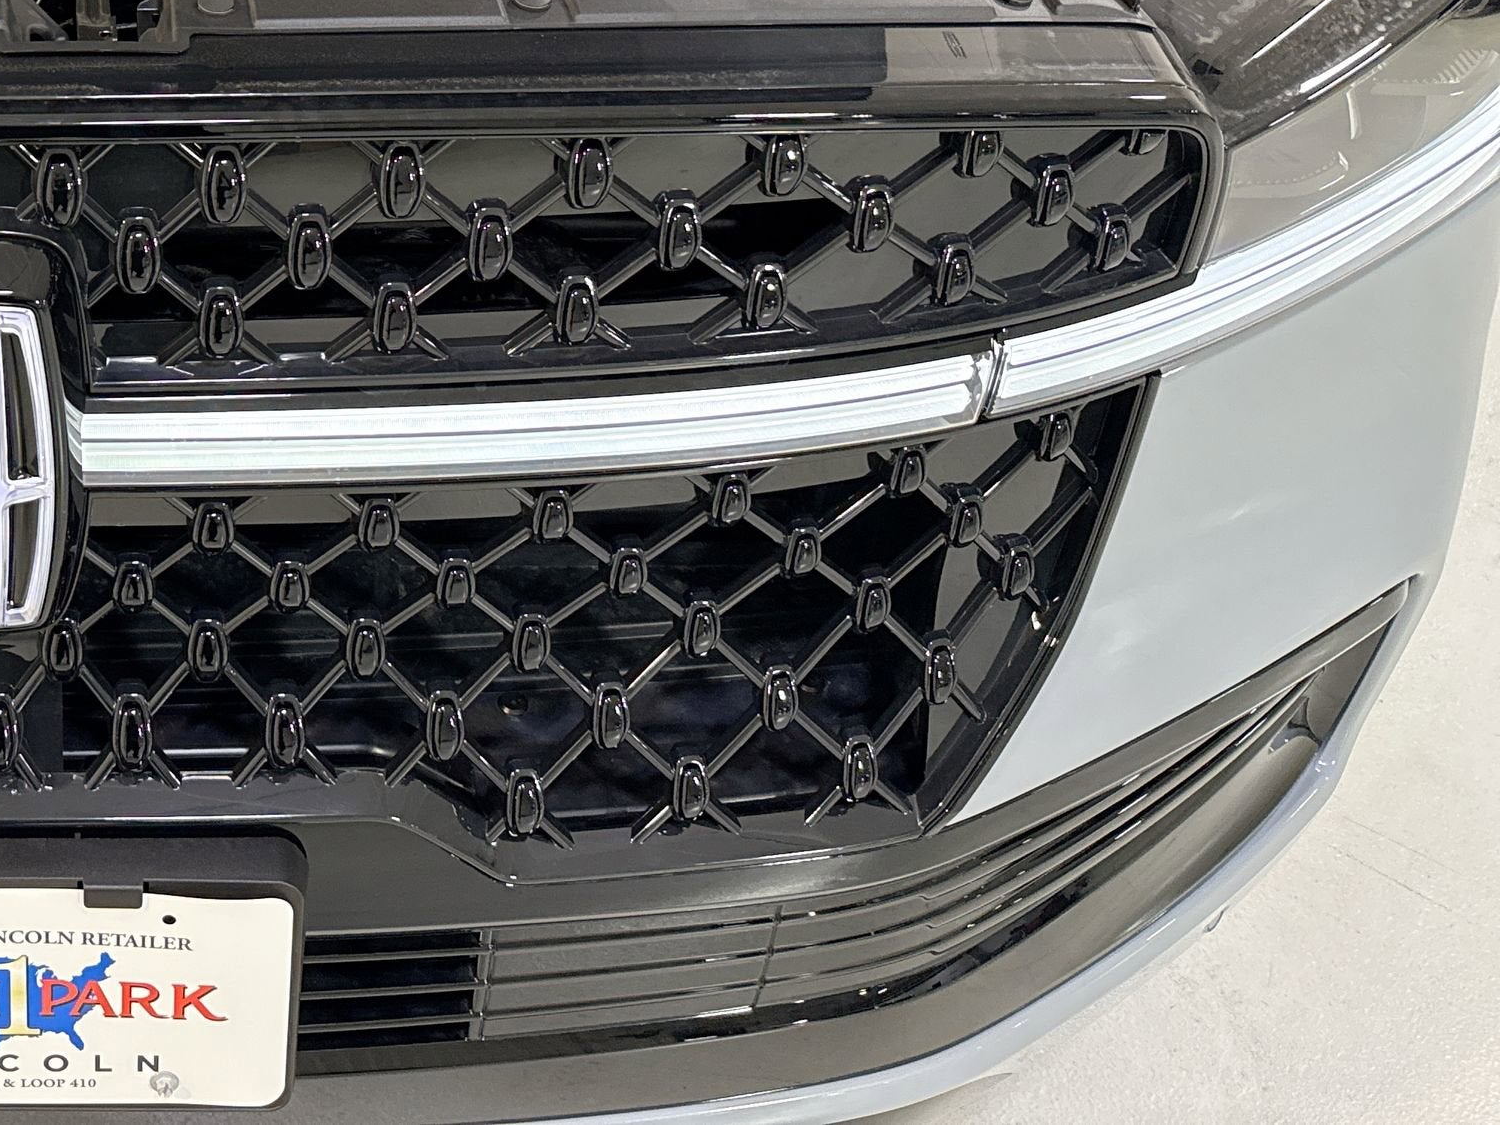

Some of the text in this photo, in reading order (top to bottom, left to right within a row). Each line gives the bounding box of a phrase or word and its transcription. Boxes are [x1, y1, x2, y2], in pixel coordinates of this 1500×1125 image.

[81, 930, 194, 952] RETAILER
[39, 978, 229, 1022] PARK
[3, 1078, 16, 1088] &
[21, 1078, 66, 1088] LOOP
[69, 1078, 97, 1088] 410
